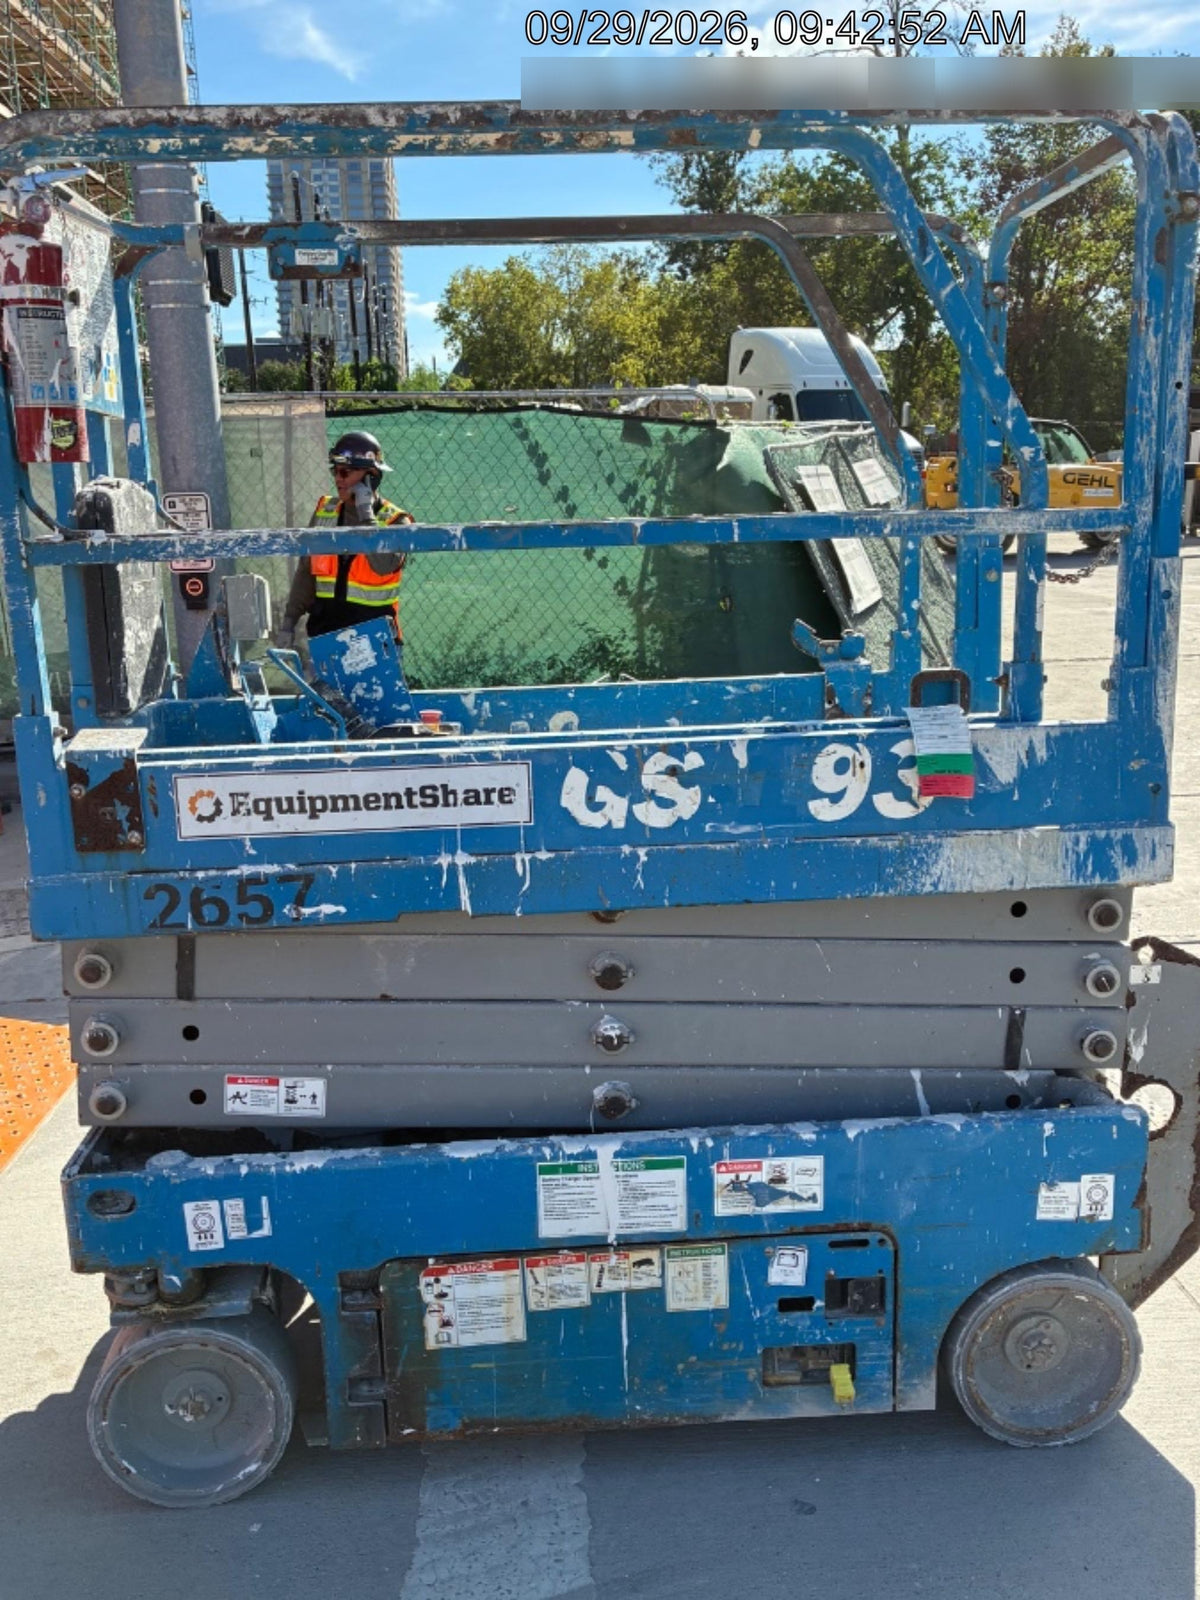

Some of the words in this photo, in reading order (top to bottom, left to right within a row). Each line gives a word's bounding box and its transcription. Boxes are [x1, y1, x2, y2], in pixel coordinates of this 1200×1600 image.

[1062, 472, 1115, 488] GEHL
[229, 784, 517, 821] EquipmentShare
[143, 874, 315, 928] 2657
[577, 1160, 646, 1173] INSTCTIONS
[728, 1163, 759, 1171] DANGER
[456, 1262, 495, 1273] DANGER
